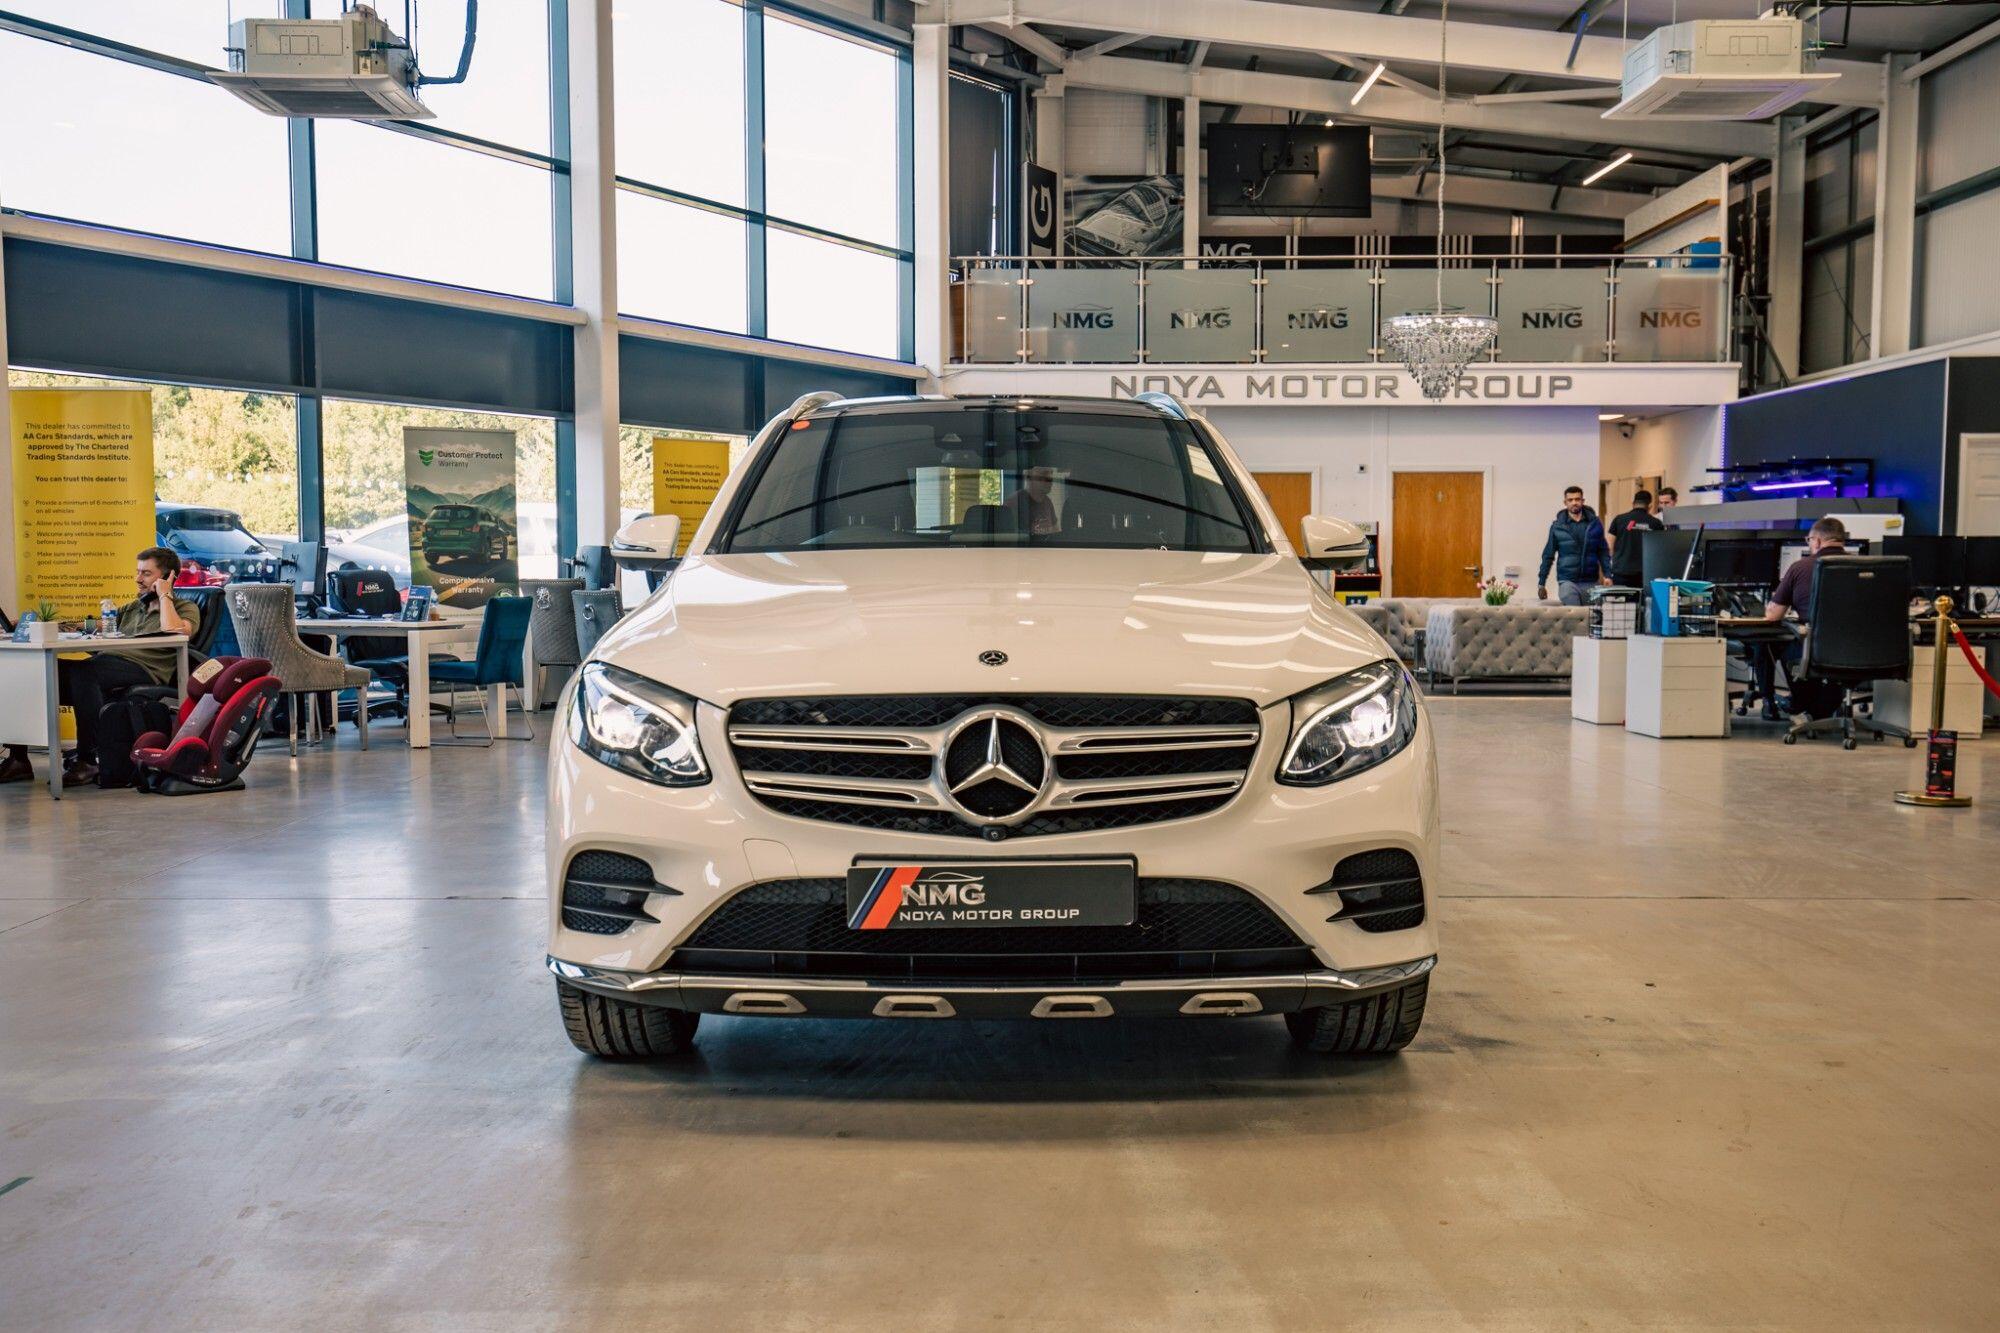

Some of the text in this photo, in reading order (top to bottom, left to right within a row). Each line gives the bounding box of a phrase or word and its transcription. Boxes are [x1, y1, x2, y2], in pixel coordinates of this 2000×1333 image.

[1203, 243, 1252, 263] MG
[1053, 313, 1113, 329] NMG
[1171, 313, 1231, 329] NMG
[1288, 313, 1348, 329] NMG
[1522, 311, 1583, 329] NMG
[1640, 311, 1701, 329] NMG
[1111, 375, 1573, 398] NOYA MOTOR ROUP
[438, 460, 468, 468] Warranty
[901, 884, 986, 906] NMG
[900, 908, 1080, 921] NOYA MOTOR GROUP
